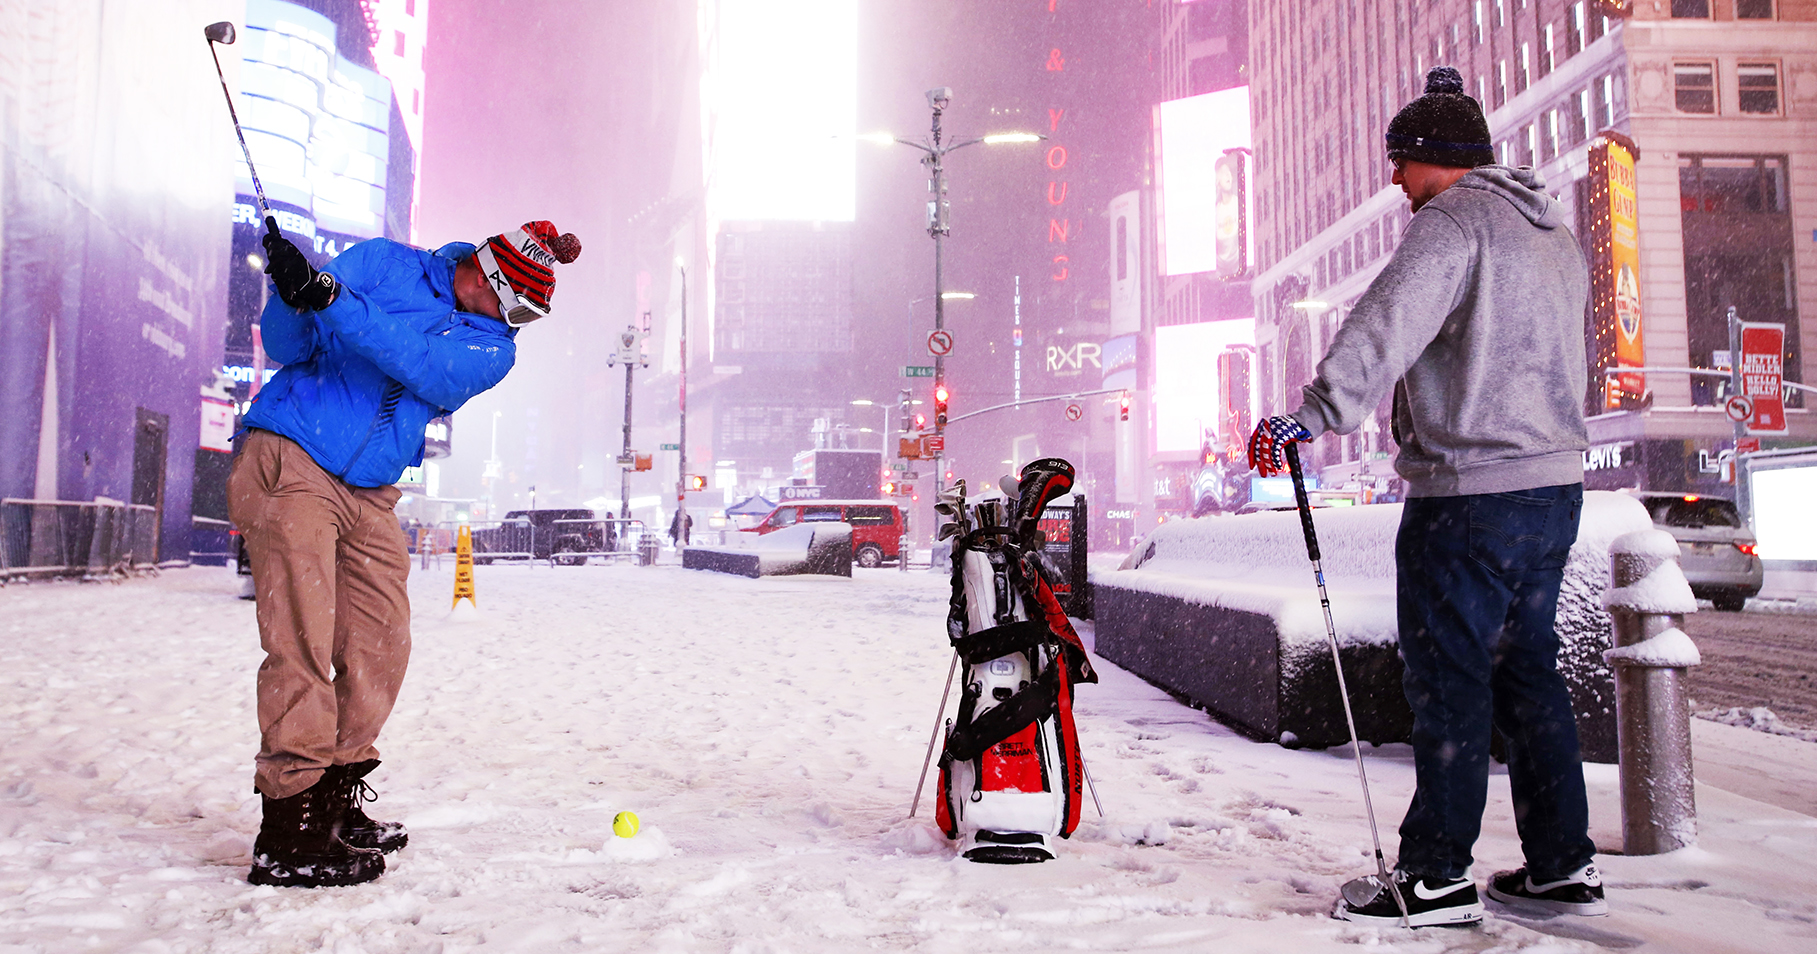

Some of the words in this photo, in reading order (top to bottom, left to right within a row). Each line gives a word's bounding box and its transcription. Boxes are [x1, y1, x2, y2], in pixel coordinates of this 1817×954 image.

[1046, 342, 1102, 372] RXR
[1745, 353, 1779, 364] BETTE
[1743, 363, 1780, 374] MIDLER
[1746, 375, 1777, 385] HELLO
[1747, 384, 1779, 396] DOLLY!
[796, 488, 821, 498] NYC
